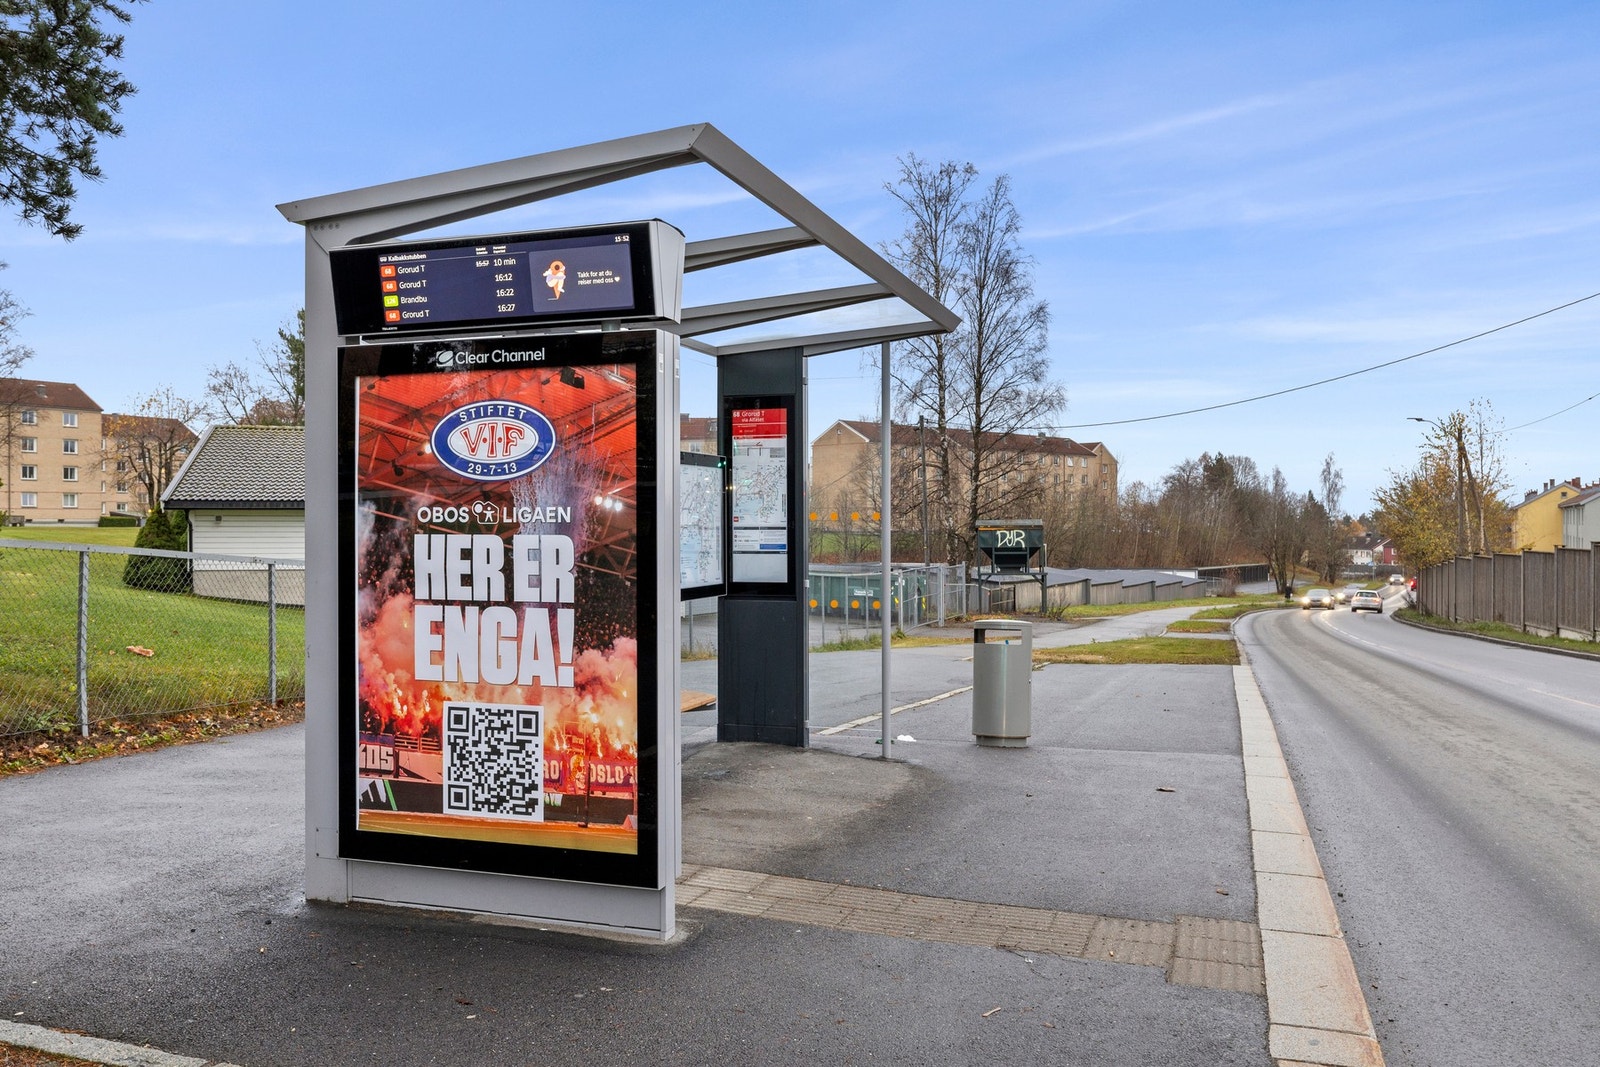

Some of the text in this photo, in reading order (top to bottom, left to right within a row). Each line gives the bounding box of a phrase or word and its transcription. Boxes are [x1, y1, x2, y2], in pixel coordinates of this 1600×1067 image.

[614, 235, 630, 243] 15:52
[494, 258, 502, 267] 10
[503, 258, 516, 266] min
[397, 265, 419, 274] Grorud
[420, 264, 425, 272] T
[495, 273, 513, 282] 16:12
[399, 280, 421, 289] Grorud
[496, 288, 515, 297] 16:22
[400, 295, 428, 304] Brandbu
[498, 304, 516, 312] 16:27
[402, 310, 424, 319] Grorud
[424, 309, 430, 317] T
[455, 347, 545, 365] Clear Channel
[459, 405, 527, 422] STIFTET
[467, 462, 518, 475] 29-7-13
[417, 506, 571, 523] OBOS LIGAEN
[414, 534, 575, 603] HER ER
[414, 604, 575, 688] ENGA!
